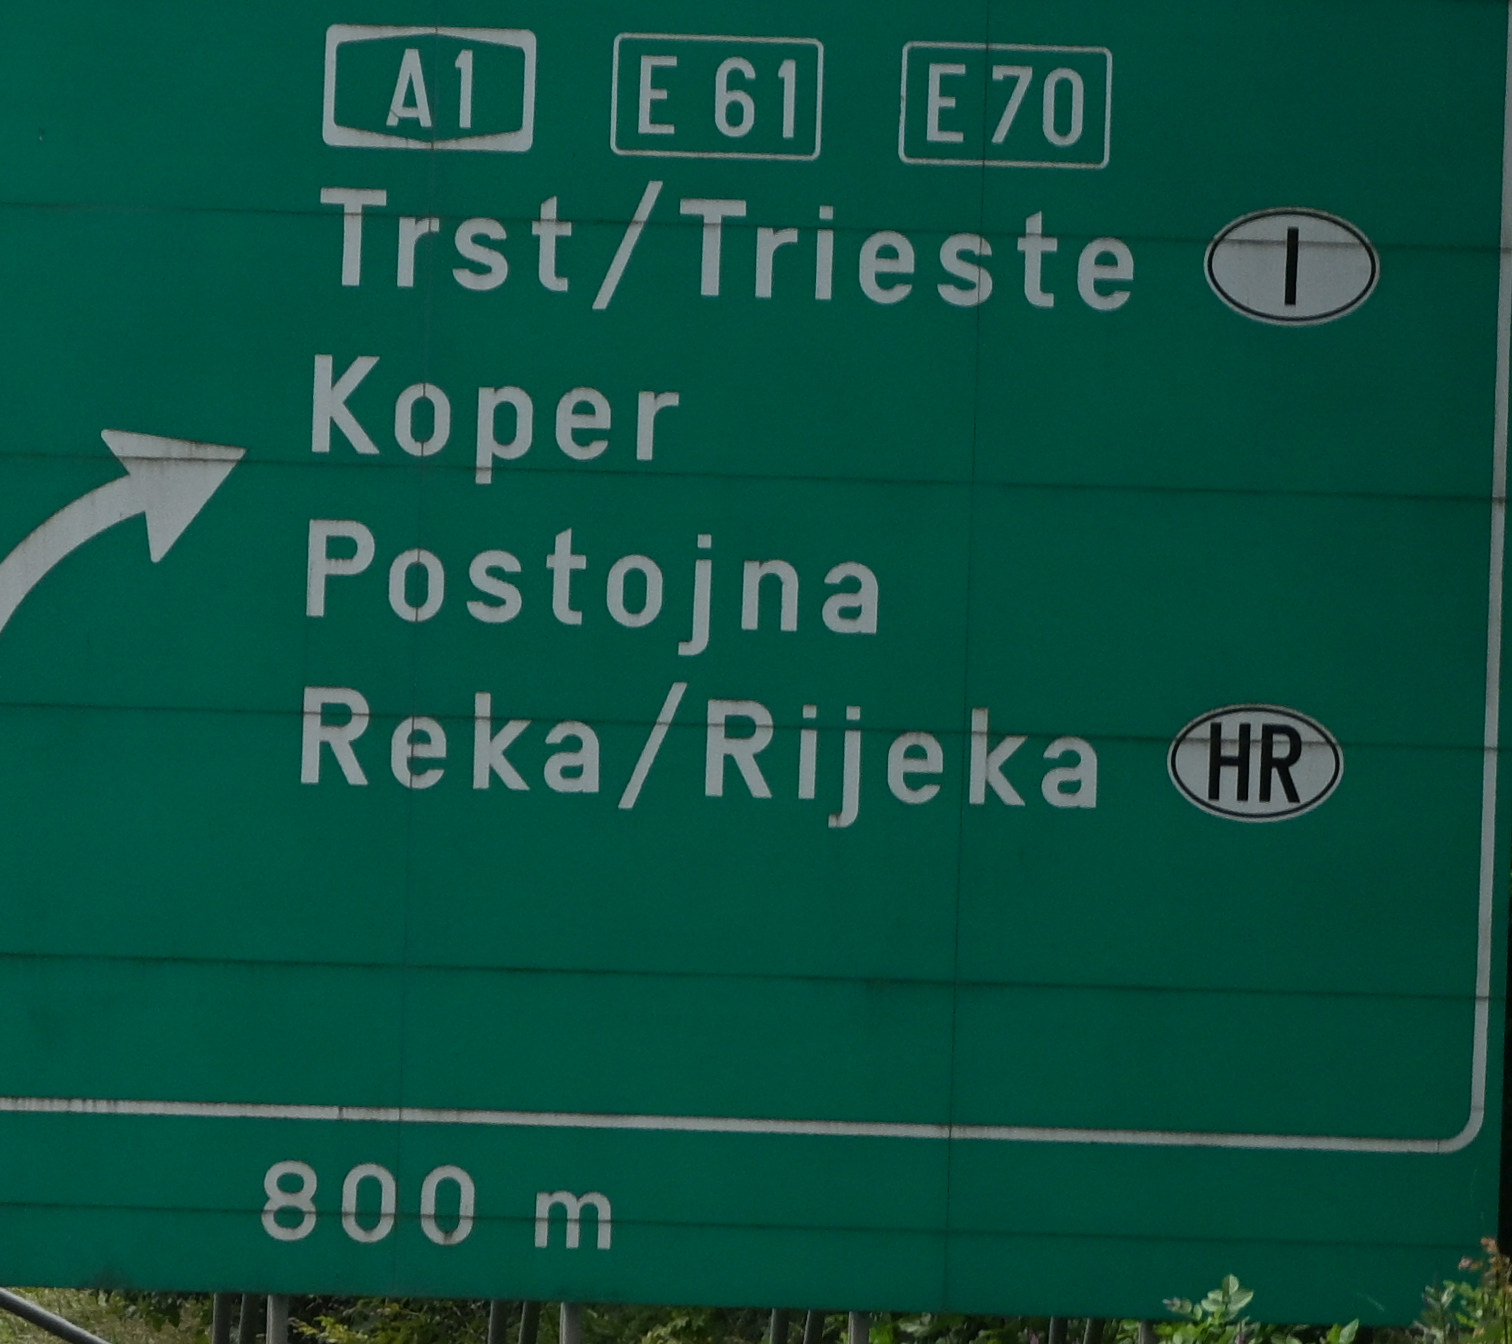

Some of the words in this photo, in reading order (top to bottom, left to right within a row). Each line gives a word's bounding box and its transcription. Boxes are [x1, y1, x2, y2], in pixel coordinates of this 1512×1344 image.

[385, 47, 477, 130] A1
[639, 55, 676, 138] E
[714, 59, 799, 141] 61
[927, 62, 964, 144] E
[991, 65, 1085, 148] 70
[320, 180, 1137, 311] Trst/Trieste
[312, 353, 682, 486] Koper
[306, 519, 880, 656] Postojna
[300, 683, 1101, 829] Reka/Rijeka
[1206, 724, 1302, 805] HR
[261, 1160, 477, 1248] 800
[535, 1184, 614, 1252] m
